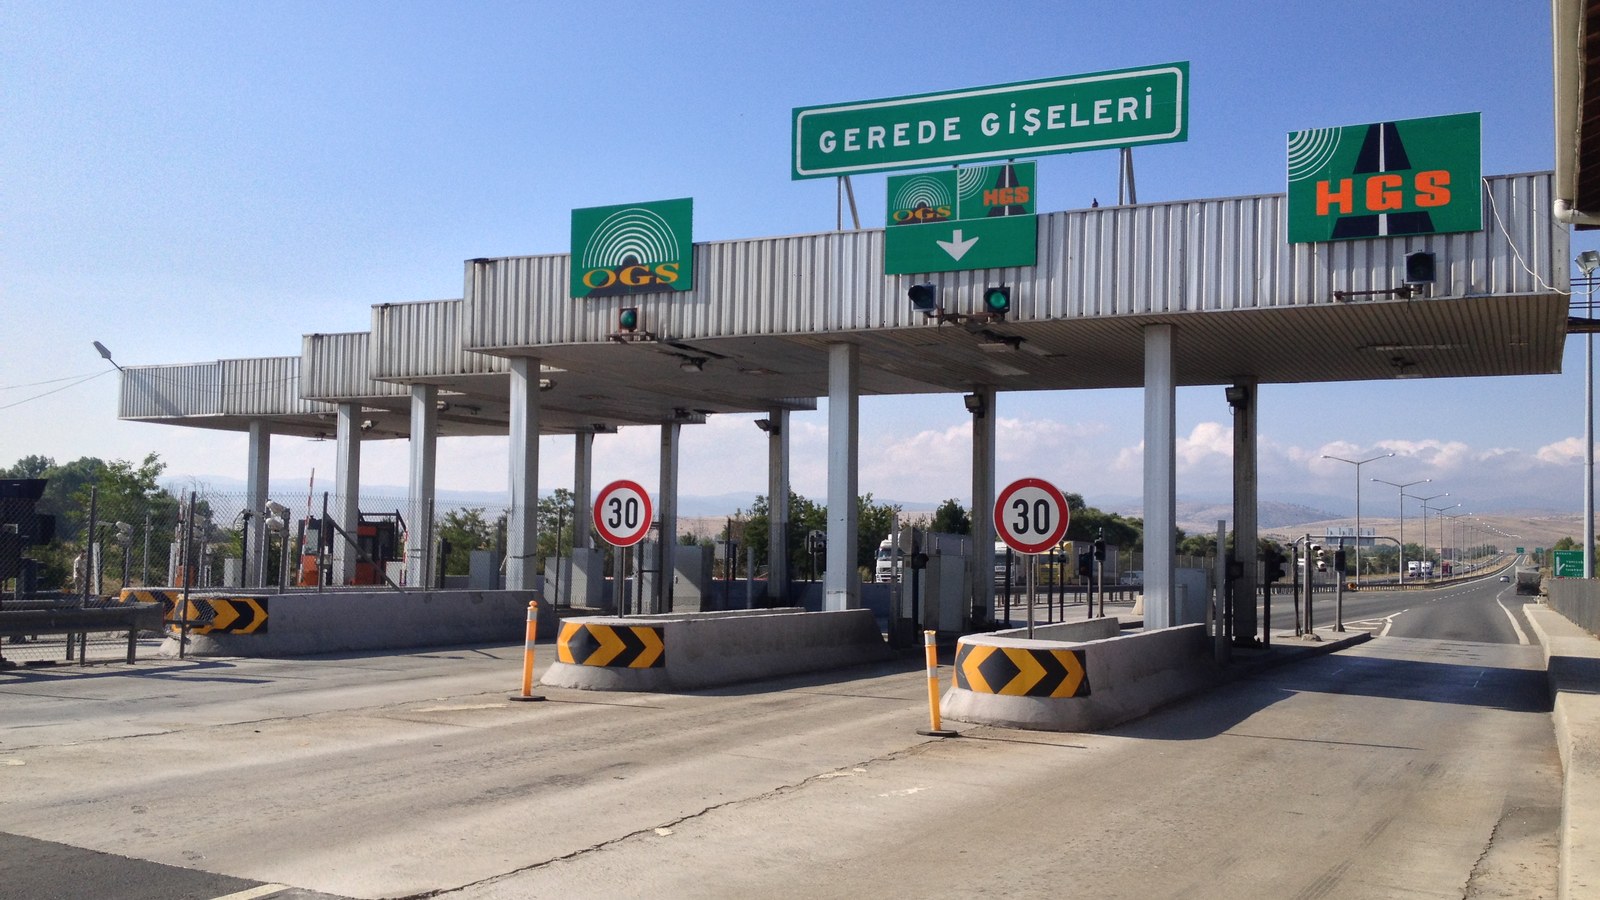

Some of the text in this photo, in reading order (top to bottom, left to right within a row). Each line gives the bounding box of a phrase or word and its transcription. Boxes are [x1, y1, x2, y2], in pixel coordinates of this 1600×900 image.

[819, 86, 1153, 154] GEREDE GİŞELERİ
[983, 186, 1029, 206] HGS
[1316, 170, 1450, 216] HGS
[892, 205, 951, 222] OGS
[583, 263, 679, 289] OGS
[608, 497, 638, 529] 30
[1012, 498, 1050, 535] 30
